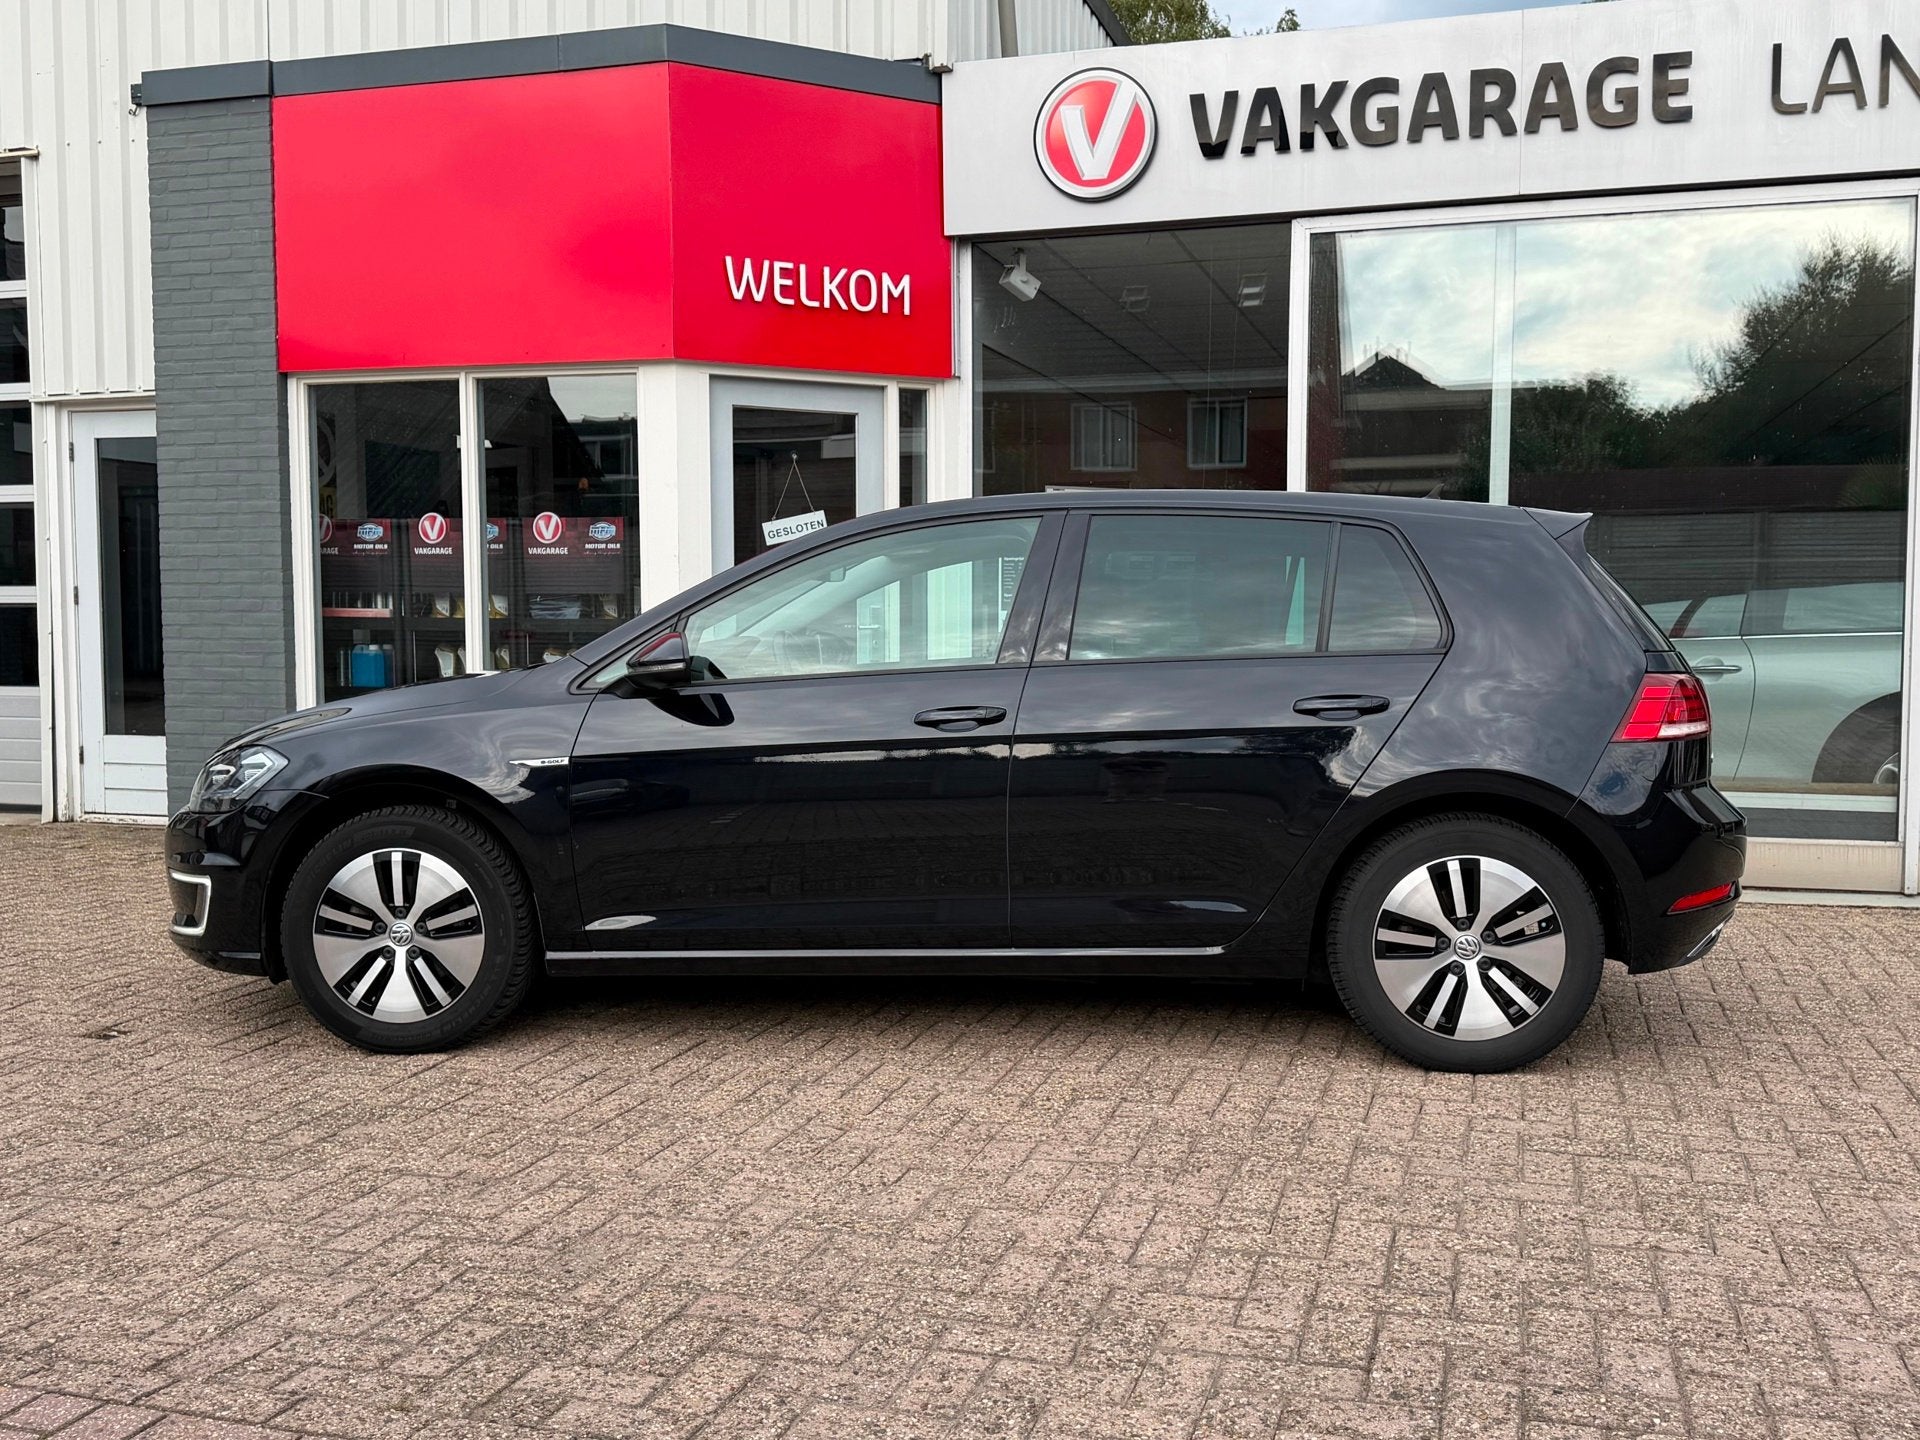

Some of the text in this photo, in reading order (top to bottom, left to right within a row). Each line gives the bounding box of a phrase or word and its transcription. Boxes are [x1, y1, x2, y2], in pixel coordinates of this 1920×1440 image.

[1189, 33, 1920, 159] VAKGARAGE LAN
[724, 255, 911, 316] WELKOM
[767, 519, 825, 539] GESLOTEN
[414, 547, 453, 555] VAKGARAGE
[528, 546, 569, 555] VAKGARAGE
